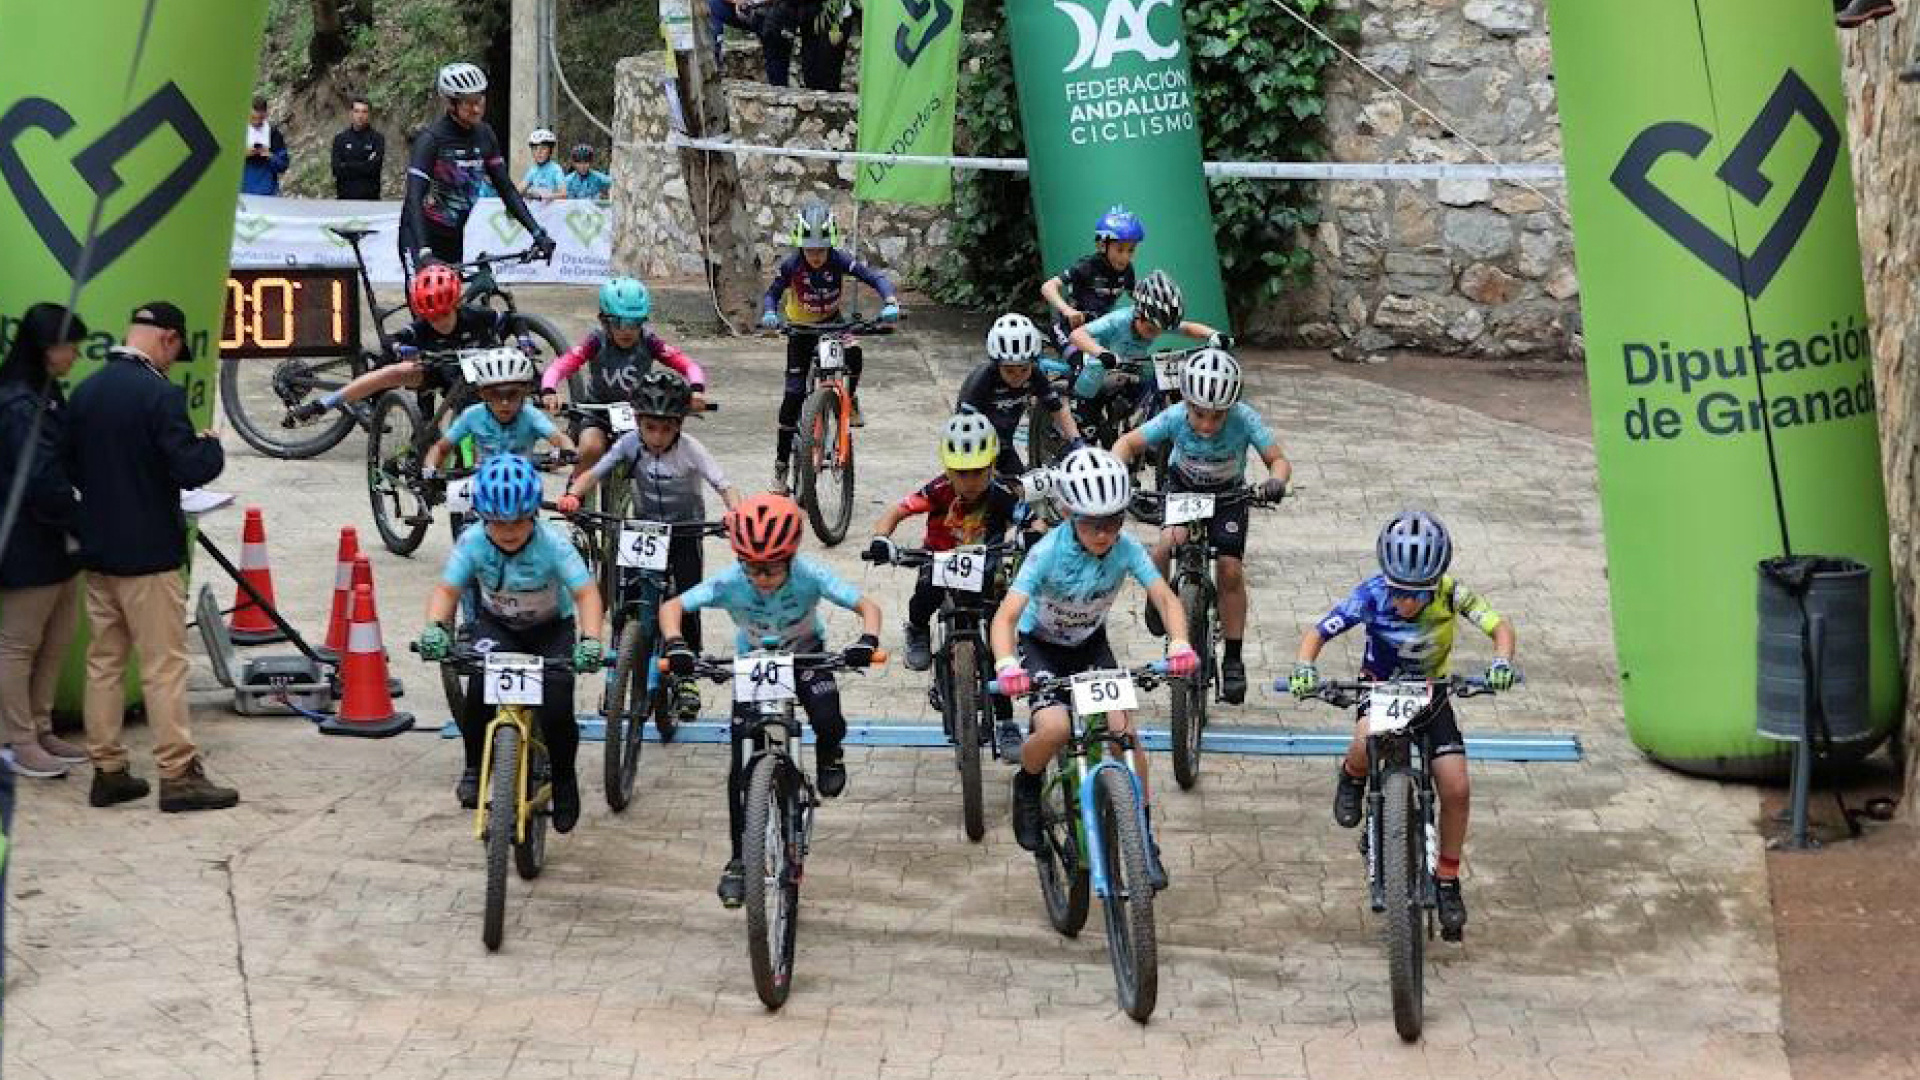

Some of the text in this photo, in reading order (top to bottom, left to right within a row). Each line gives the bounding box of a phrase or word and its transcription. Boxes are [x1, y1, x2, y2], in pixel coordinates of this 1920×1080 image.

[1065, 65, 1188, 102] FEDERACIÓN
[1070, 92, 1191, 123] ANDALUZA
[1071, 112, 1194, 145] CICLISMO
[1624, 397, 1682, 440] de
[631, 534, 657, 558] 45
[945, 553, 973, 579] 49
[499, 666, 526, 692] 51
[751, 660, 779, 686] 40
[1090, 680, 1120, 703] 50
[1386, 697, 1417, 719] 46
